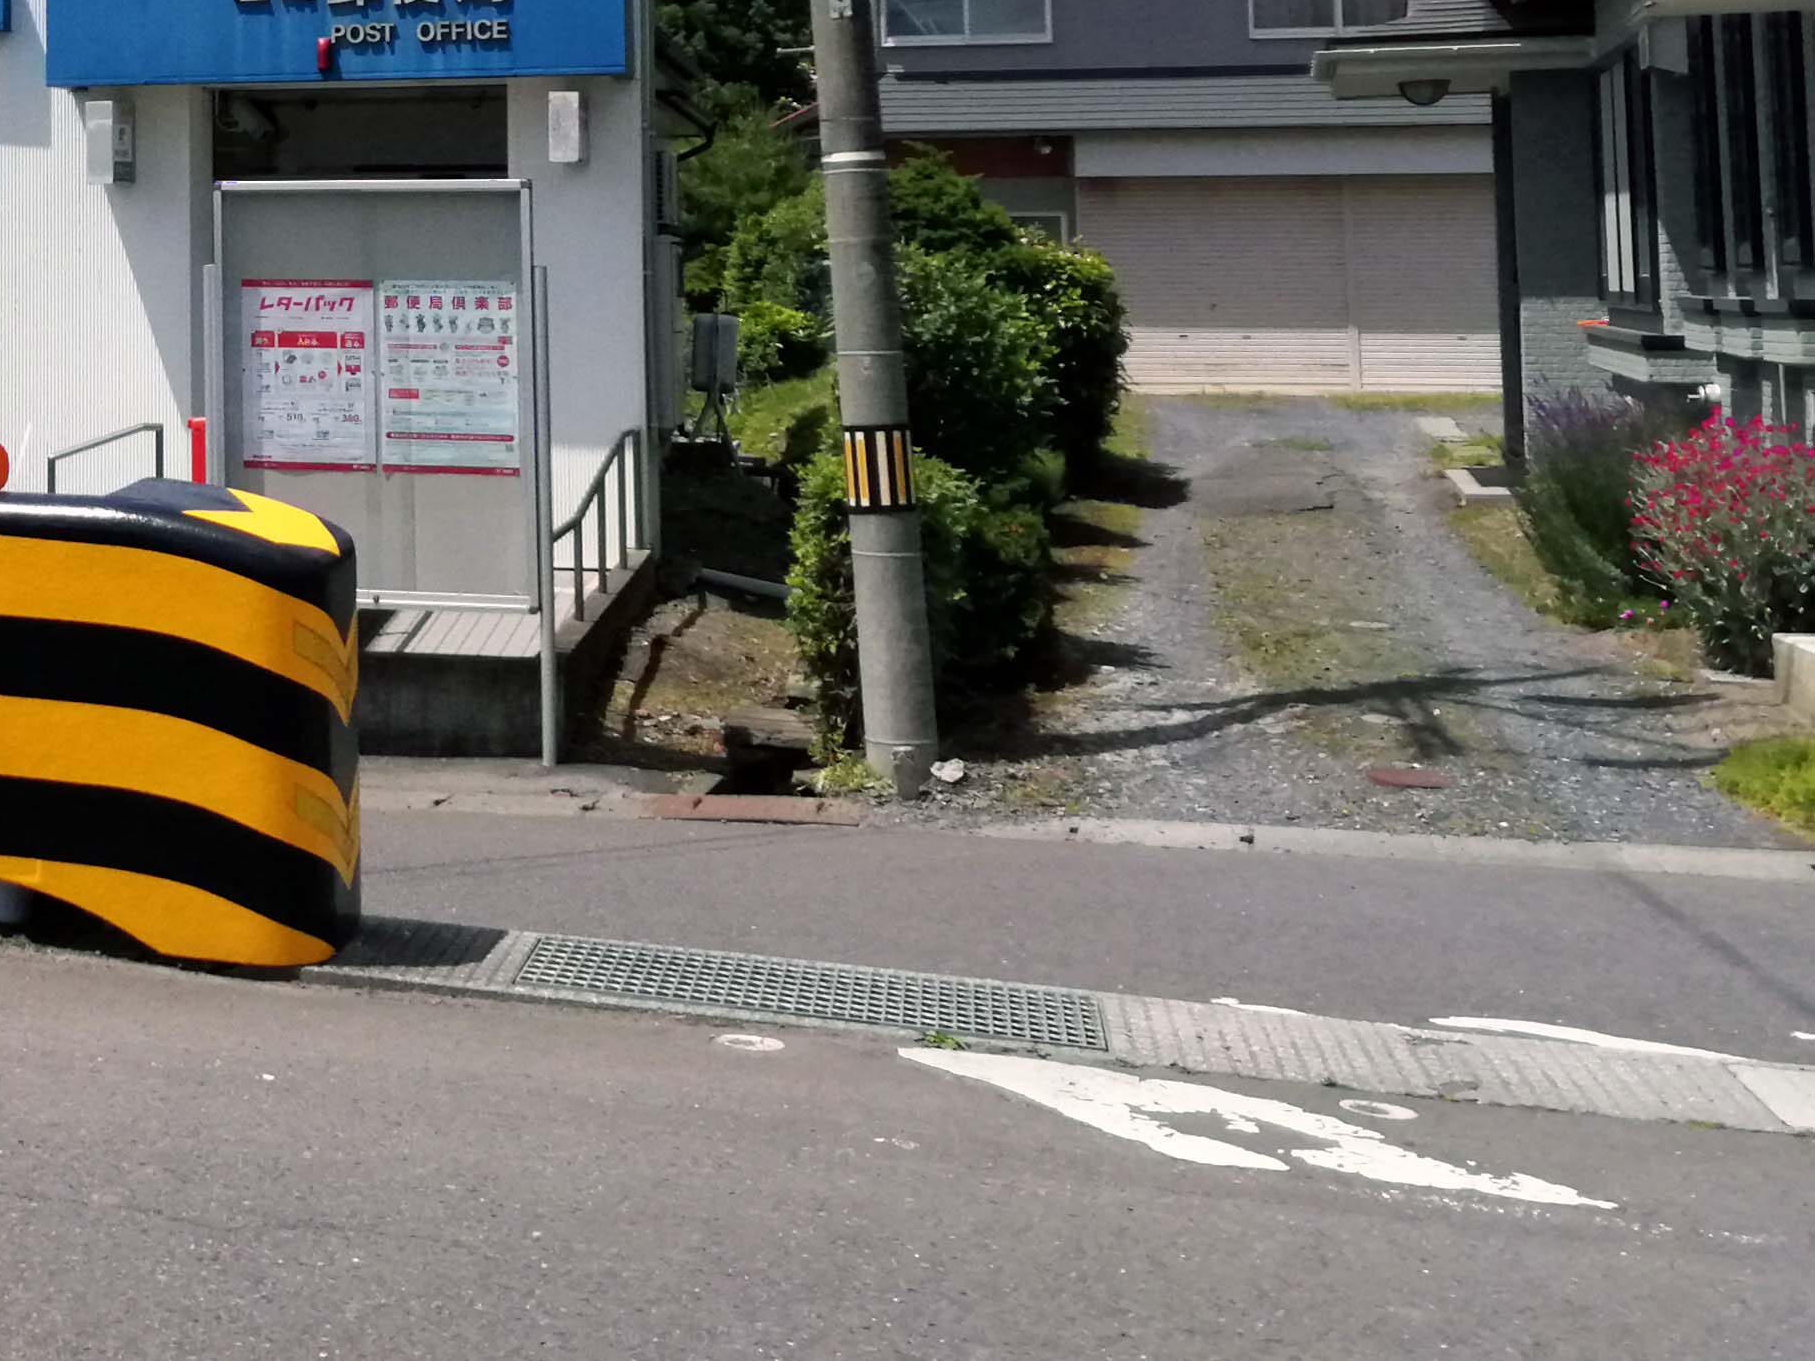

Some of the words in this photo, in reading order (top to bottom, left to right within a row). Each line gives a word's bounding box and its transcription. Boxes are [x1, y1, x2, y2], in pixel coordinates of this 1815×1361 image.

[330, 22, 396, 44] POST
[416, 19, 509, 42] OFFICE
[258, 295, 356, 312] レターパック
